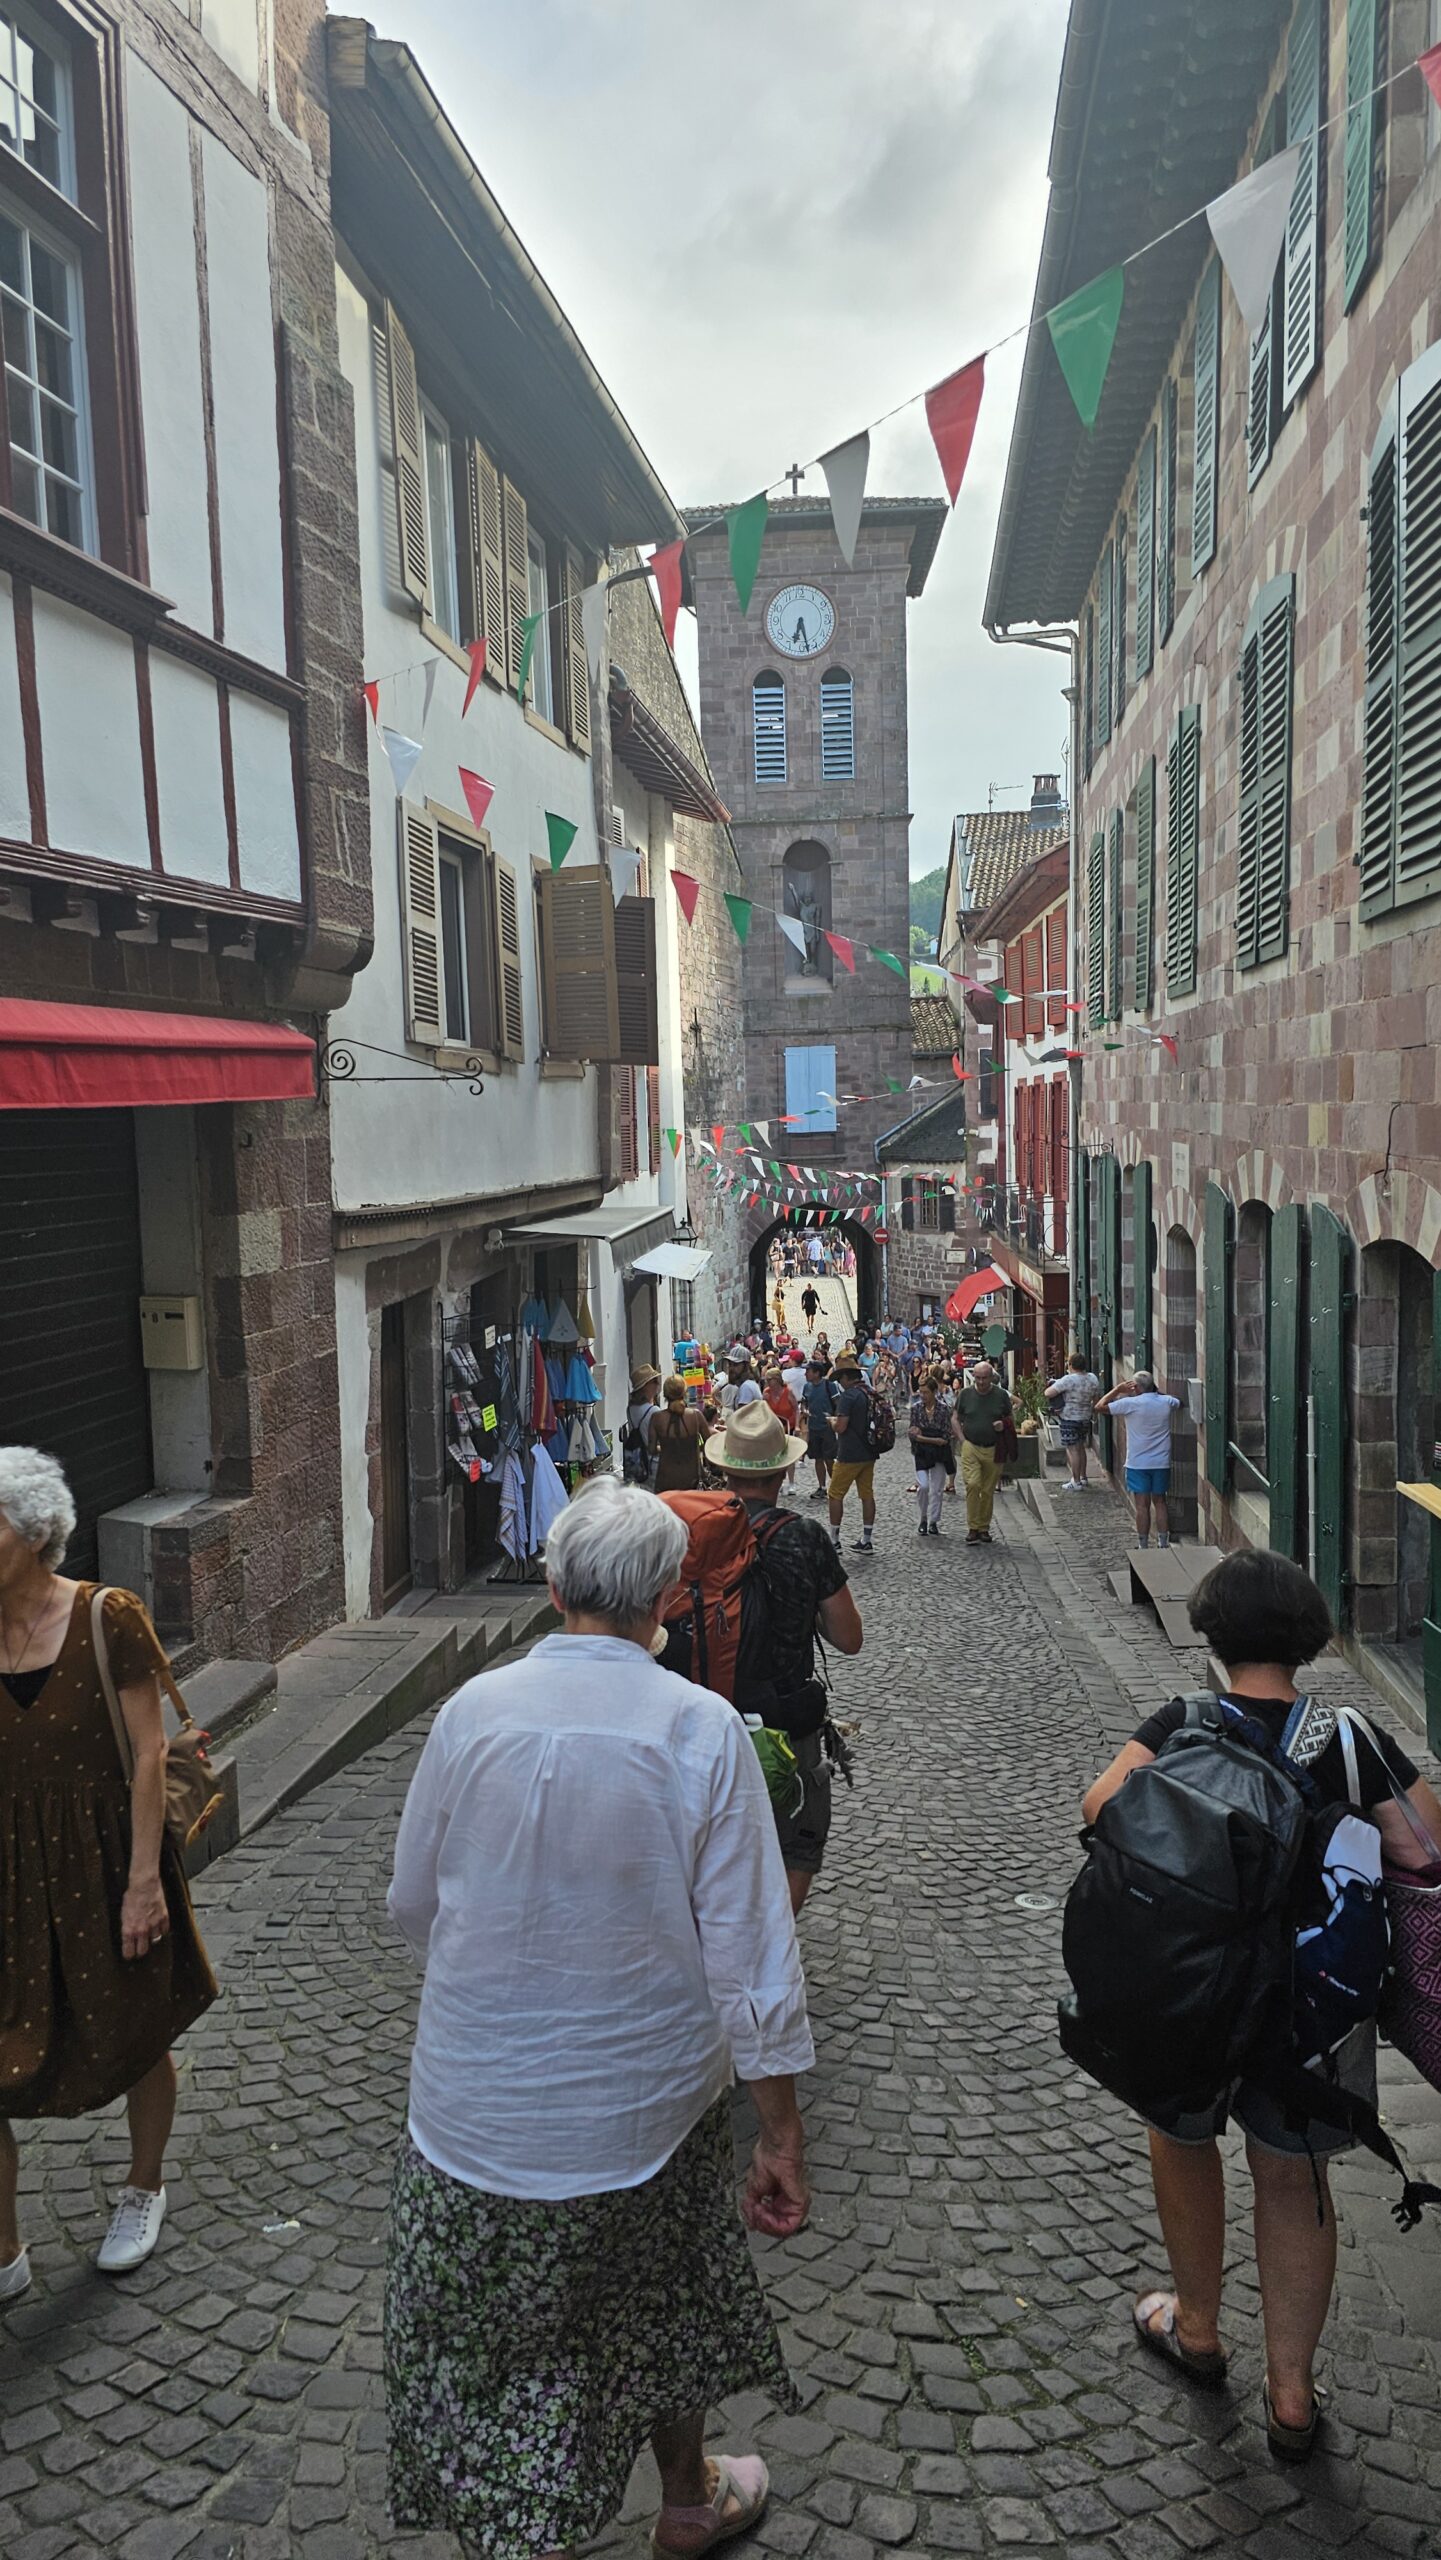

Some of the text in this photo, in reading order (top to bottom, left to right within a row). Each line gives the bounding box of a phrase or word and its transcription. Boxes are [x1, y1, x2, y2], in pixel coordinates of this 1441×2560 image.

[786, 593, 791, 602] 11
[795, 589, 804, 598] 12
[811, 592, 815, 601] 1
[820, 601, 827, 610] 2
[773, 616, 780, 625] 9
[824, 614, 831, 624] 3
[777, 629, 783, 640] 8
[786, 641, 792, 650] 7
[799, 642, 806, 651] 6
[811, 639, 817, 648] 5
